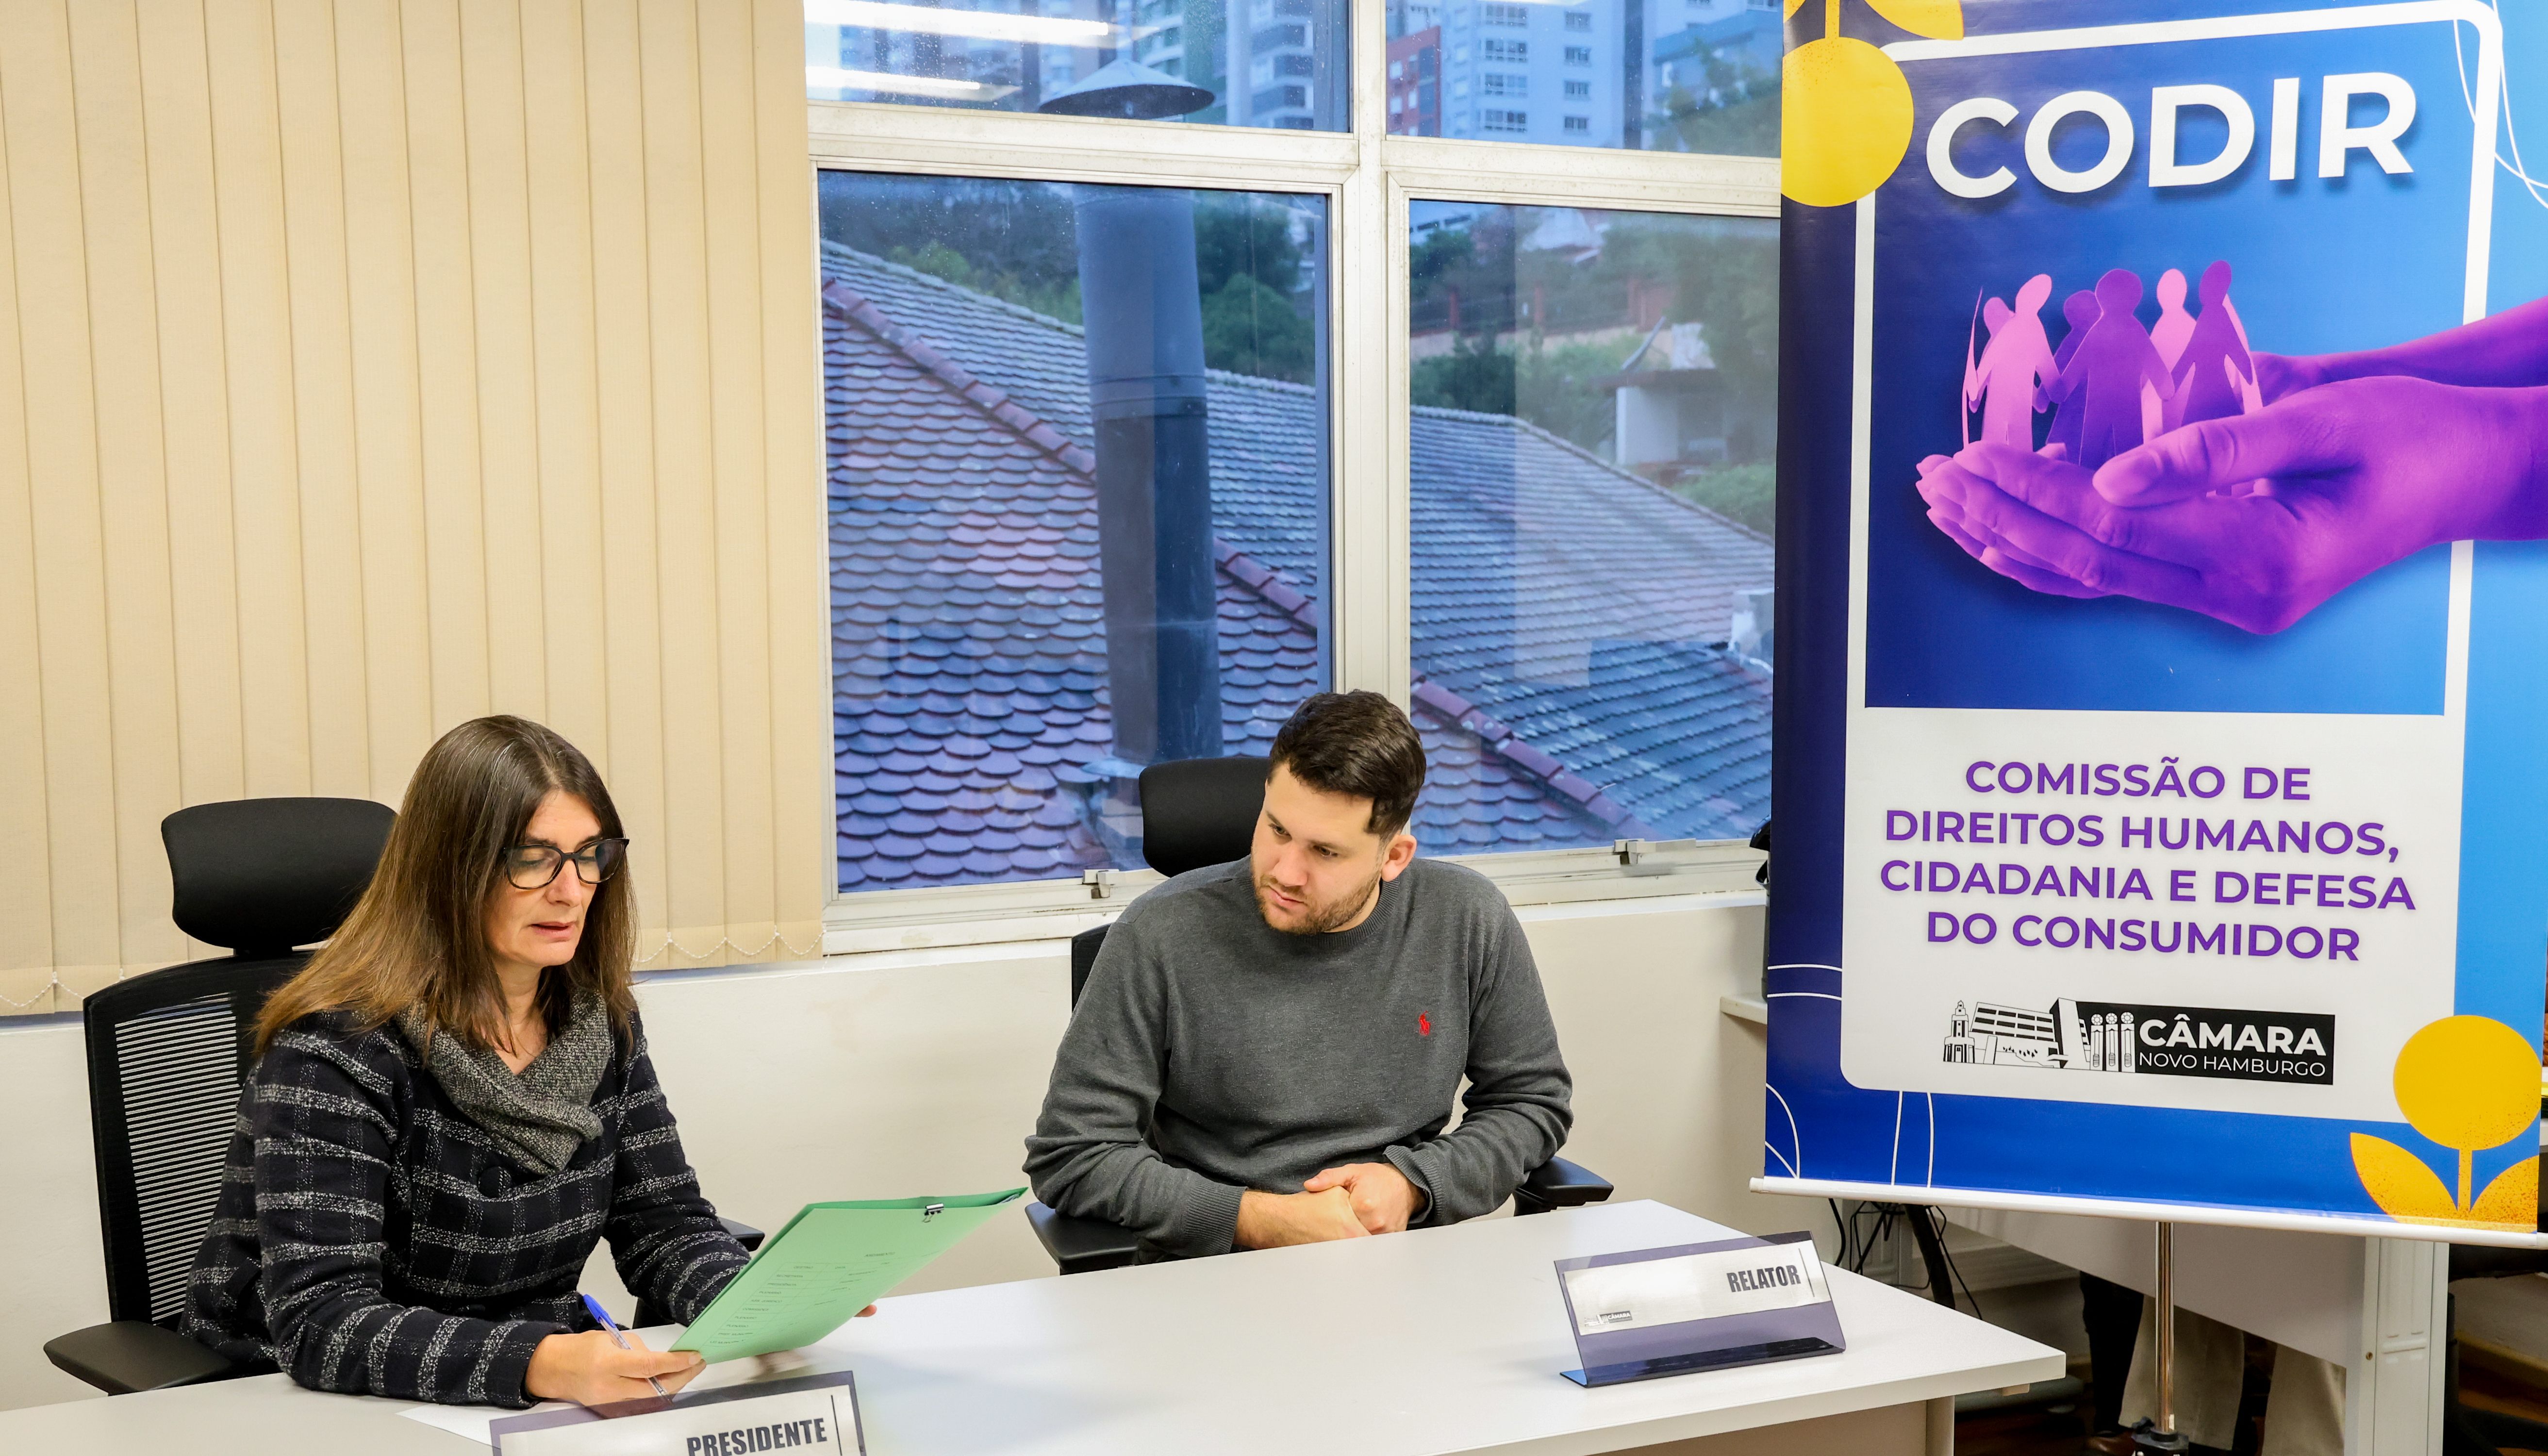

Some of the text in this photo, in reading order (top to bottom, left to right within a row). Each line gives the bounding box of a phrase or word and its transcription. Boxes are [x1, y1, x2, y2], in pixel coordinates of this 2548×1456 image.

[1926, 71, 2416, 199] CODIR
[1966, 756, 2311, 800] COMISSÃO DE
[1886, 810, 2399, 863] DIREITOS HUMANOS,
[1881, 860, 2416, 910] CIDADANIA E DEFESA
[1928, 911, 2360, 961] DO CONSUMIDOR
[2139, 1013, 2327, 1057] CÂMARA
[2139, 1052, 2325, 1077] NOVO HAMBURGO
[1726, 1265, 1801, 1292] RELATOR
[1607, 1312, 1631, 1320] CÂMARA
[686, 1417, 828, 1456] PRESIDENTE
